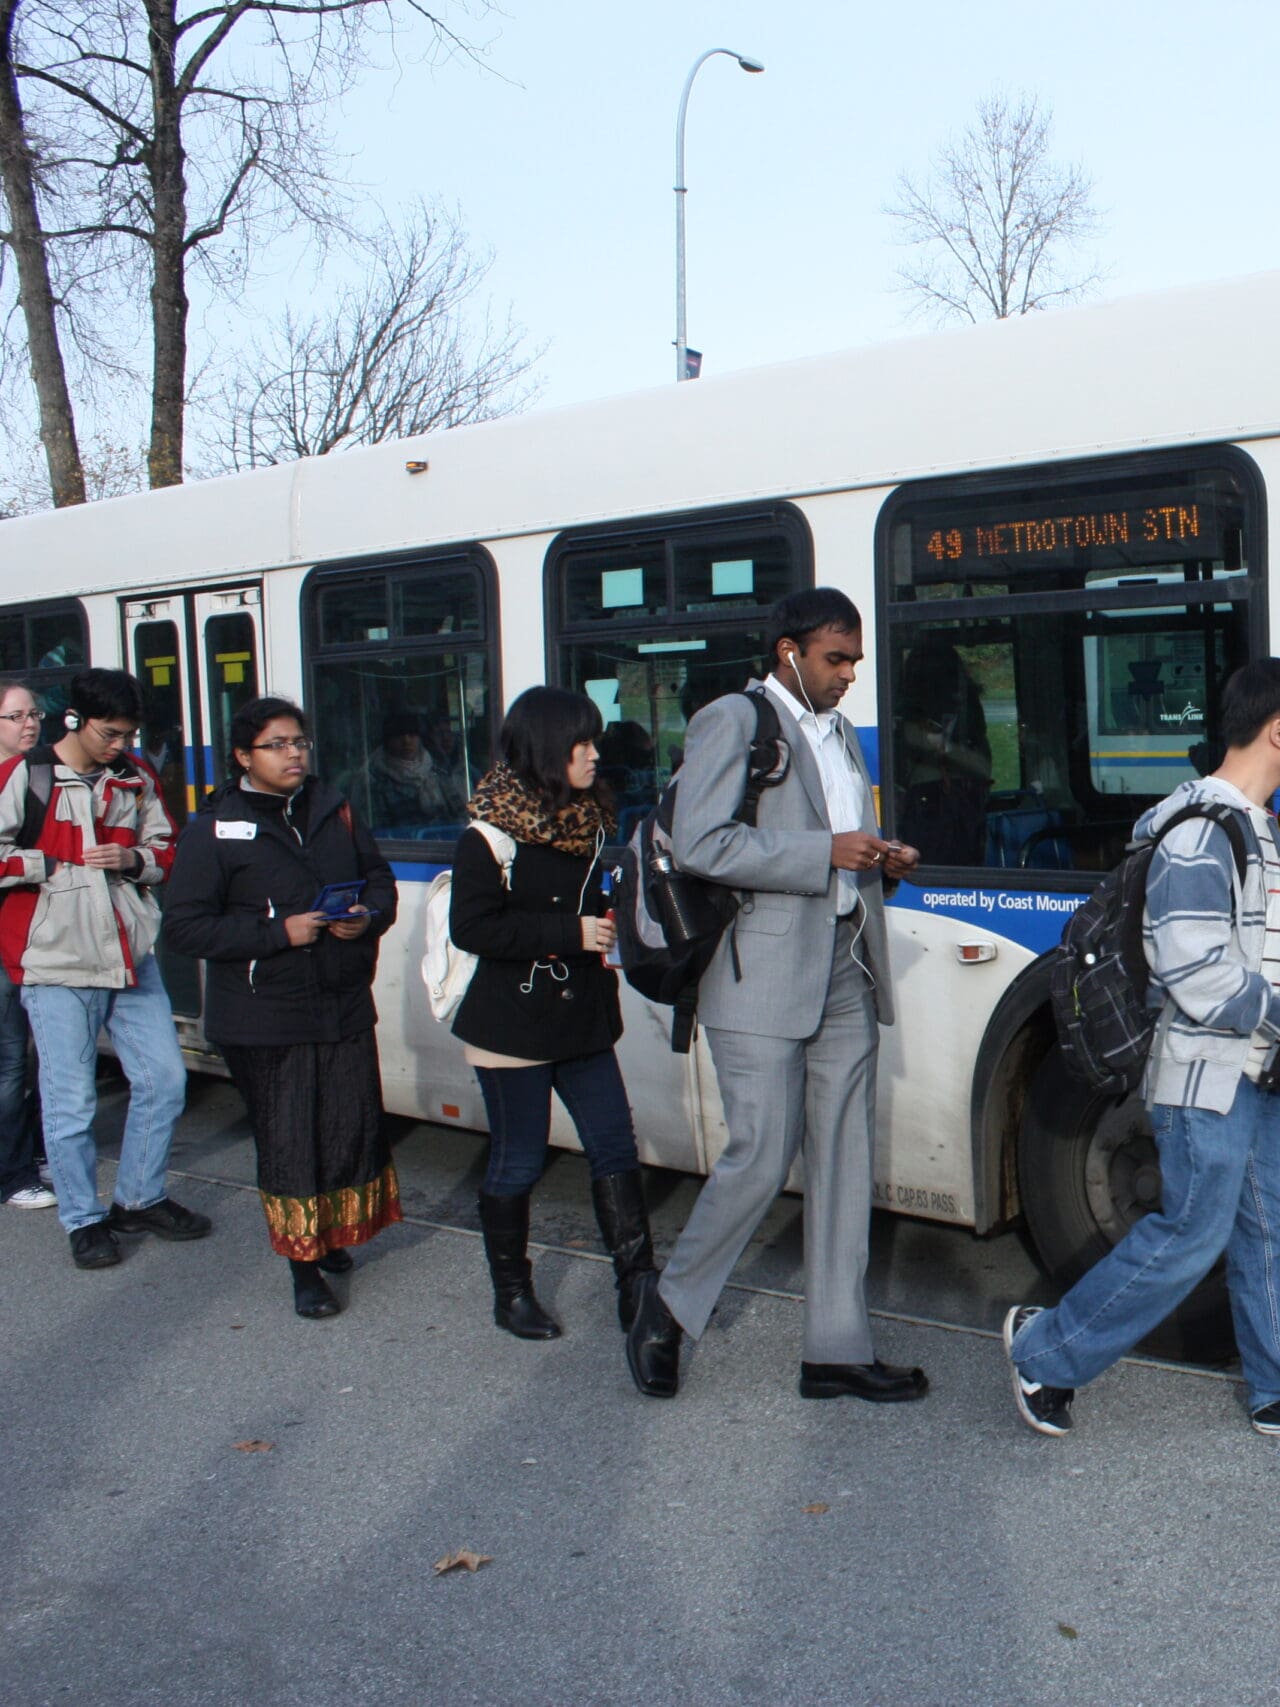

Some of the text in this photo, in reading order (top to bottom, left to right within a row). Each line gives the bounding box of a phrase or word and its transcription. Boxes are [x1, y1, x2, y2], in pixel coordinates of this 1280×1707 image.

[927, 504, 1199, 560] 49 METROTOWN STN
[923, 891, 1090, 913] operated by Coast Mount
